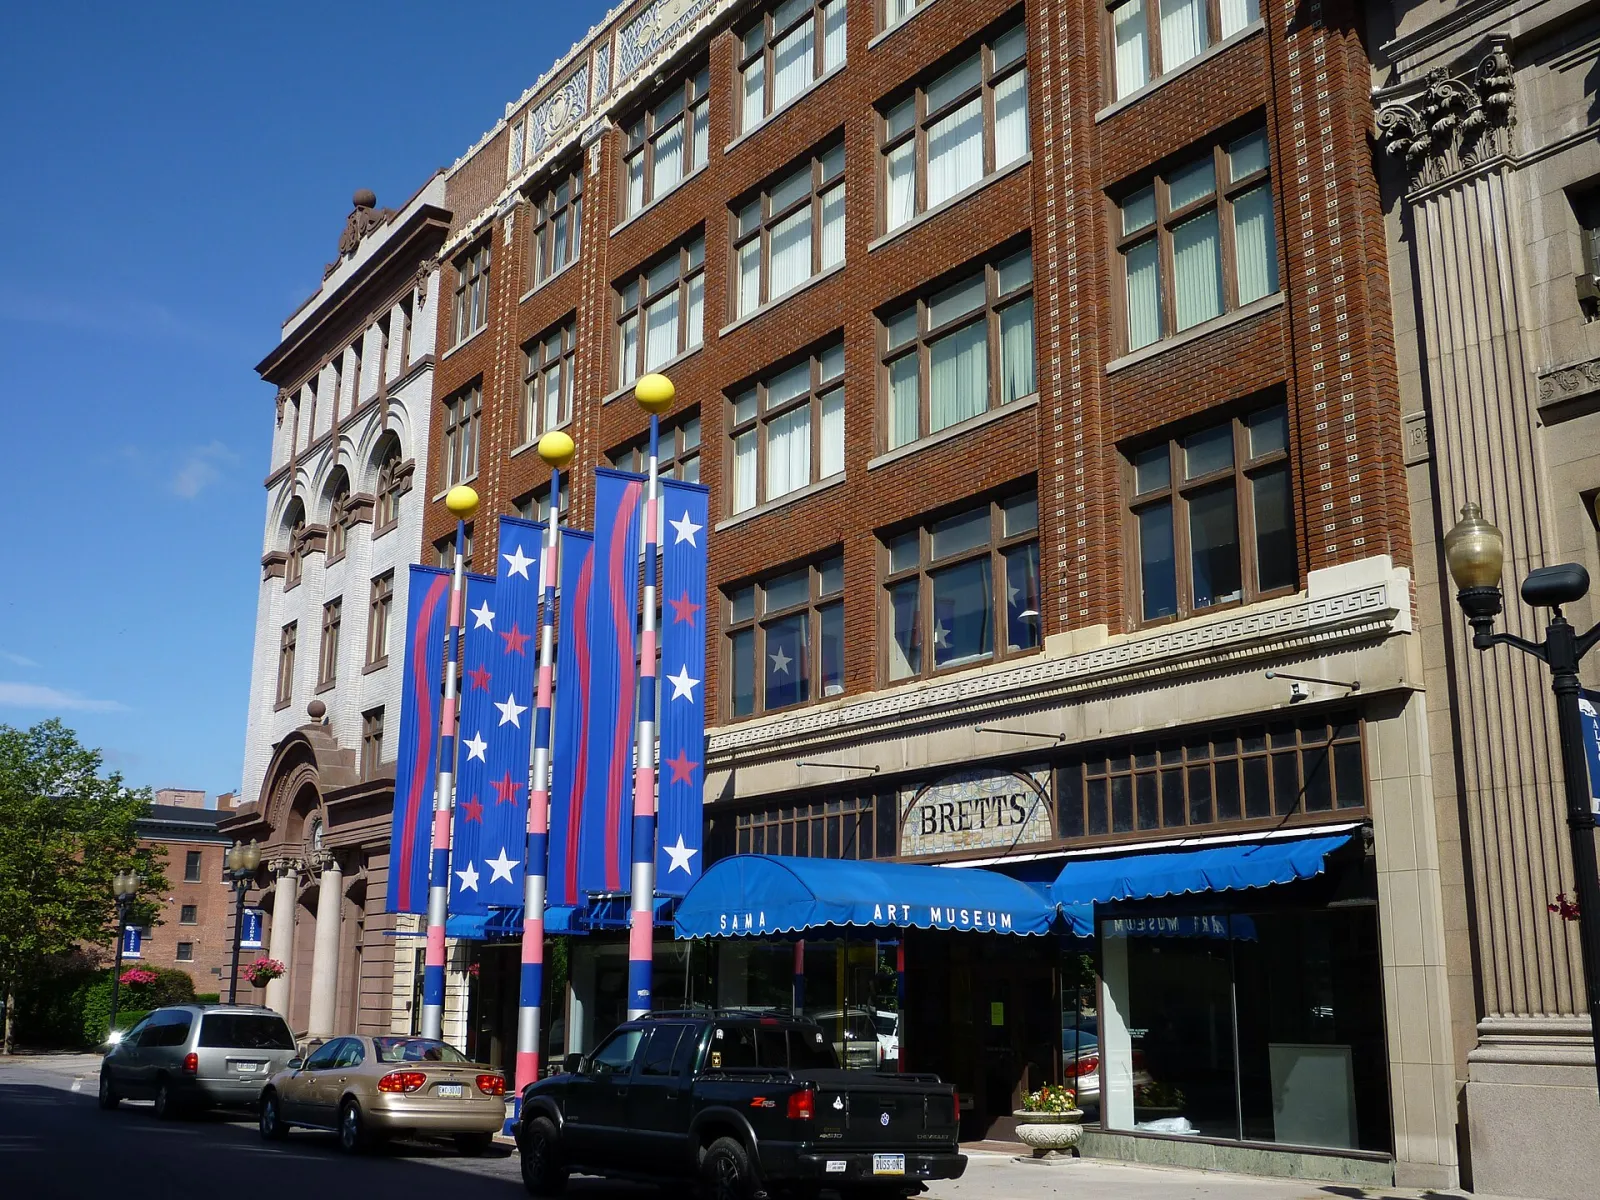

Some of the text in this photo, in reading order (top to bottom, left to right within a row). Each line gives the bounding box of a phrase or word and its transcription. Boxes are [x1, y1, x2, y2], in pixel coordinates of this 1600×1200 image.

[720, 911, 766, 930] SAMA
[873, 904, 1012, 928] ART MUSEUM
[875, 1159, 904, 1170] RUSS-ONE
